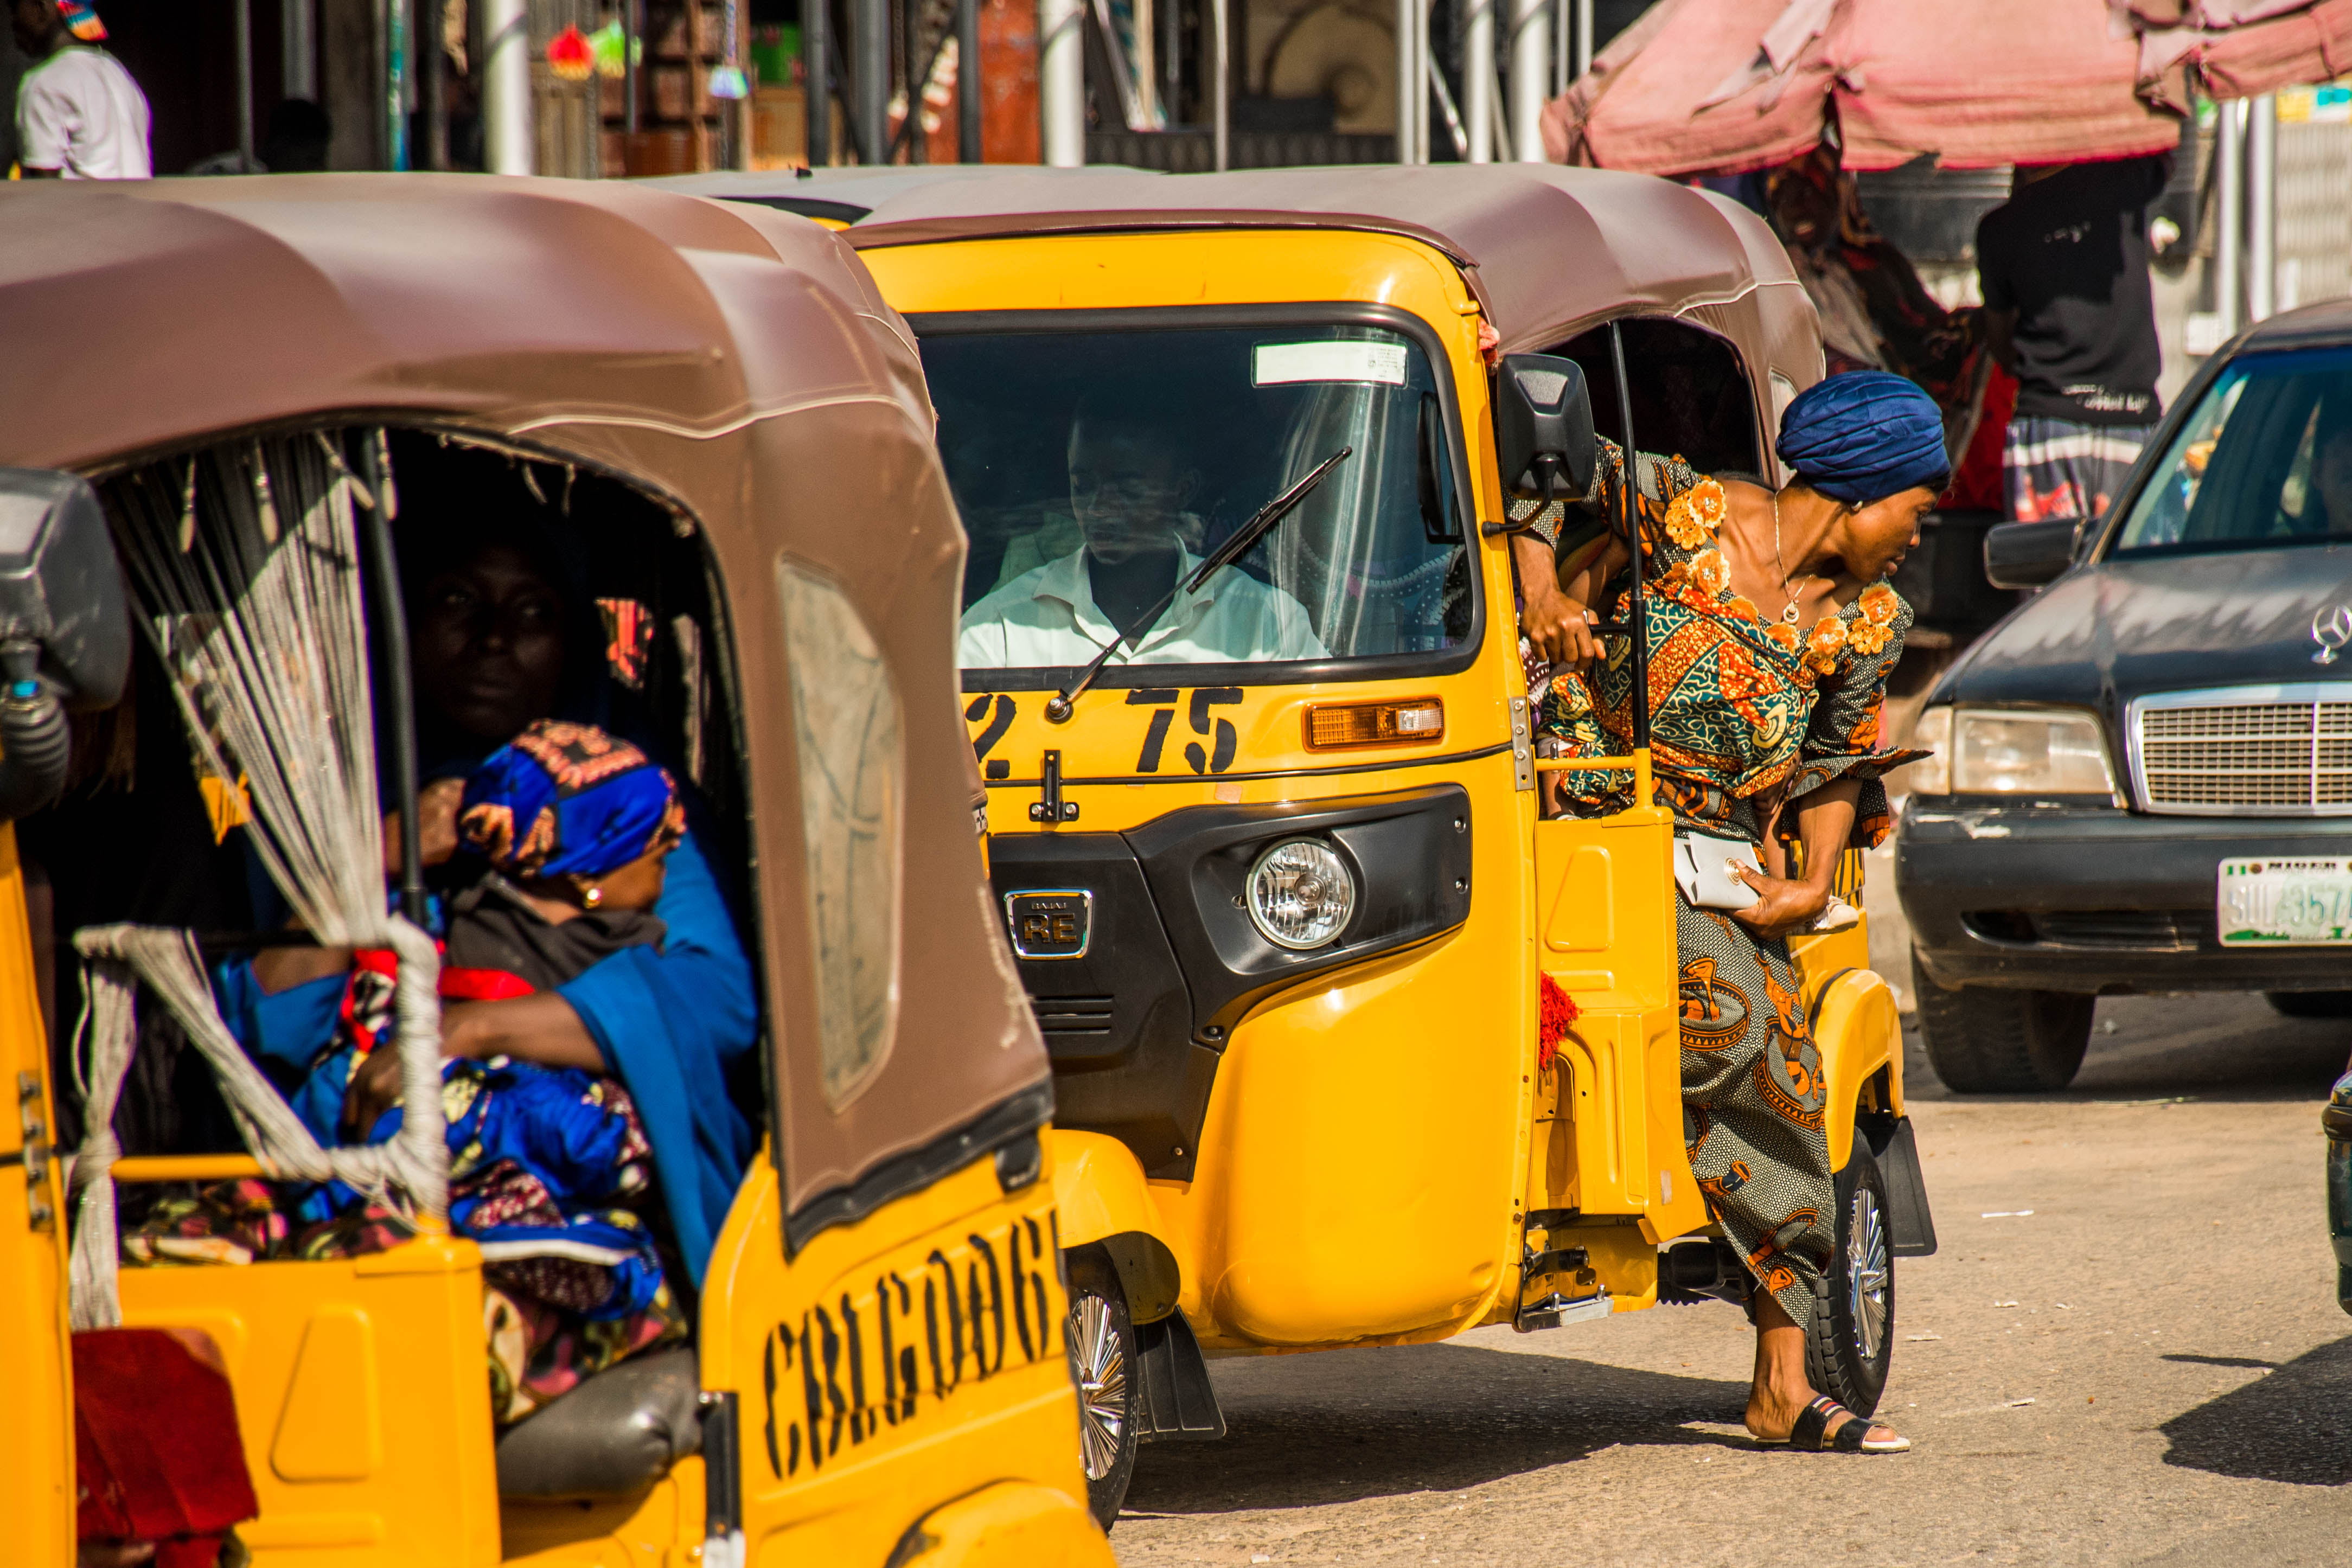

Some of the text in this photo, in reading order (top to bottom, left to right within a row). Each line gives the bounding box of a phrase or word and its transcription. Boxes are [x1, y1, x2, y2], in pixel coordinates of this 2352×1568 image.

[1124, 687, 1244, 775] 75
[1031, 901, 1067, 910] BAJAJ
[1023, 912, 1077, 944] RE
